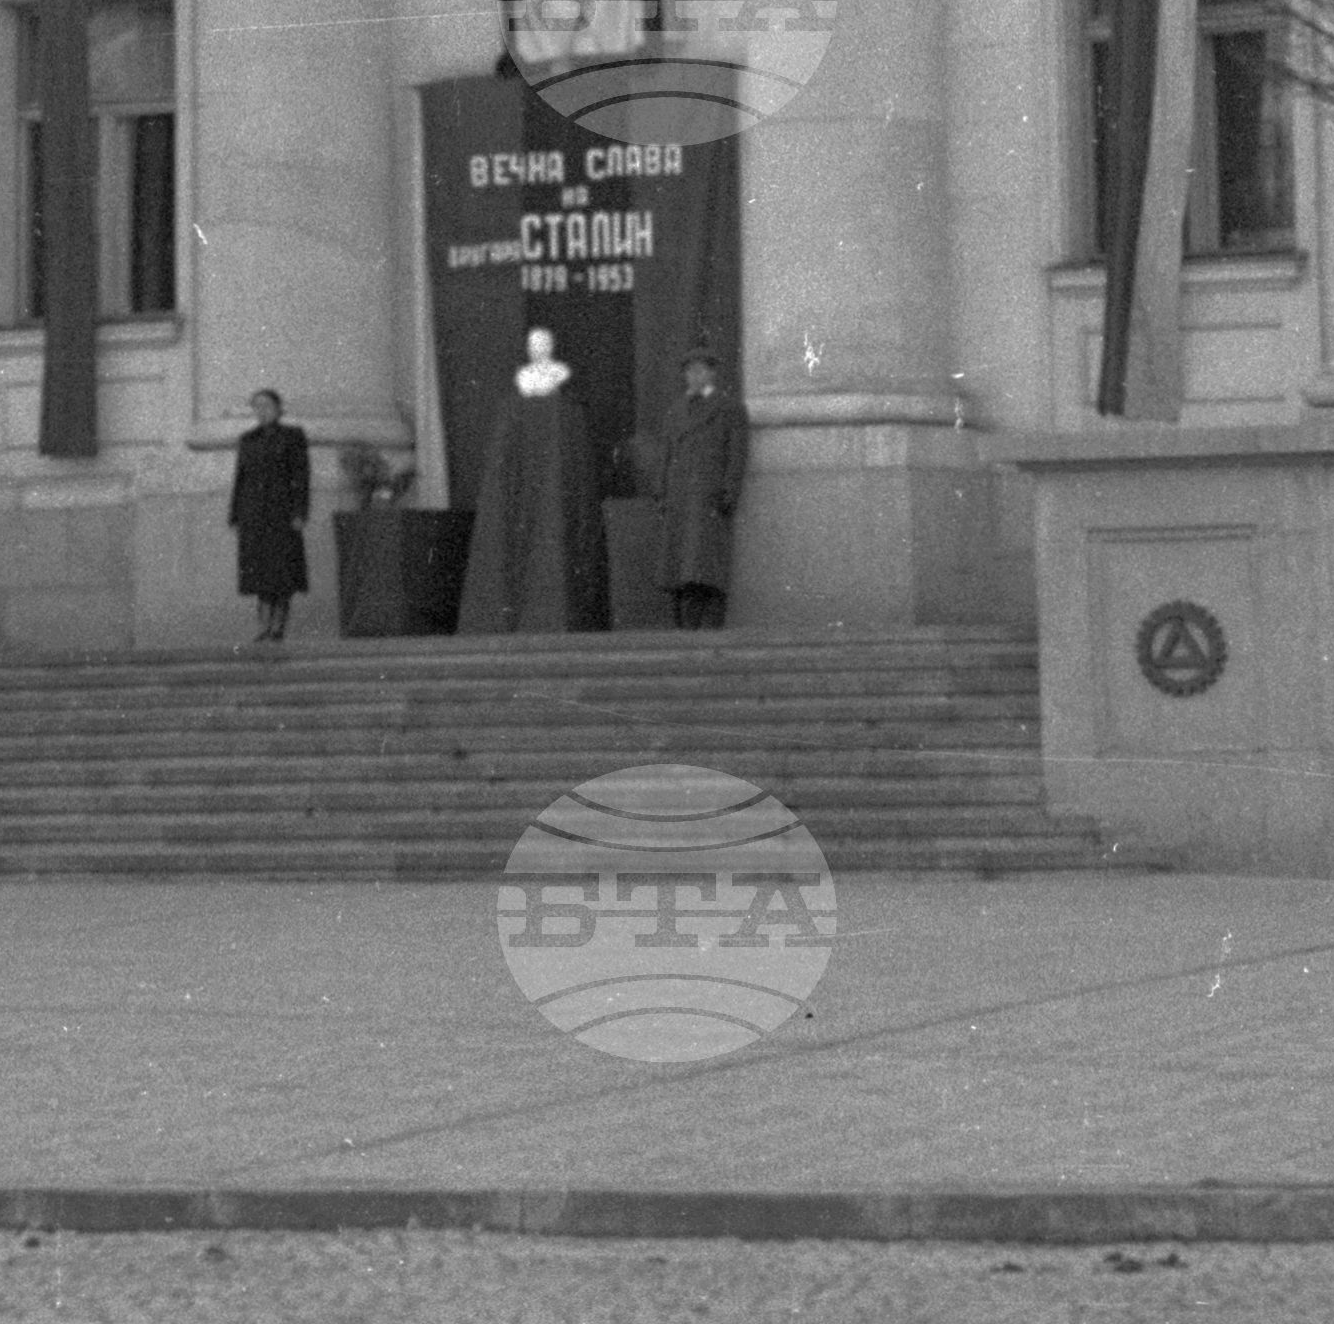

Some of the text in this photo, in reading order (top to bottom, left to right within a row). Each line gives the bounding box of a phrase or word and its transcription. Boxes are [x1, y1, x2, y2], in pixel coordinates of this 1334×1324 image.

[469, 144, 683, 187] ВЕЧНА СЛАВА
[520, 209, 653, 260] СТАЛИН
